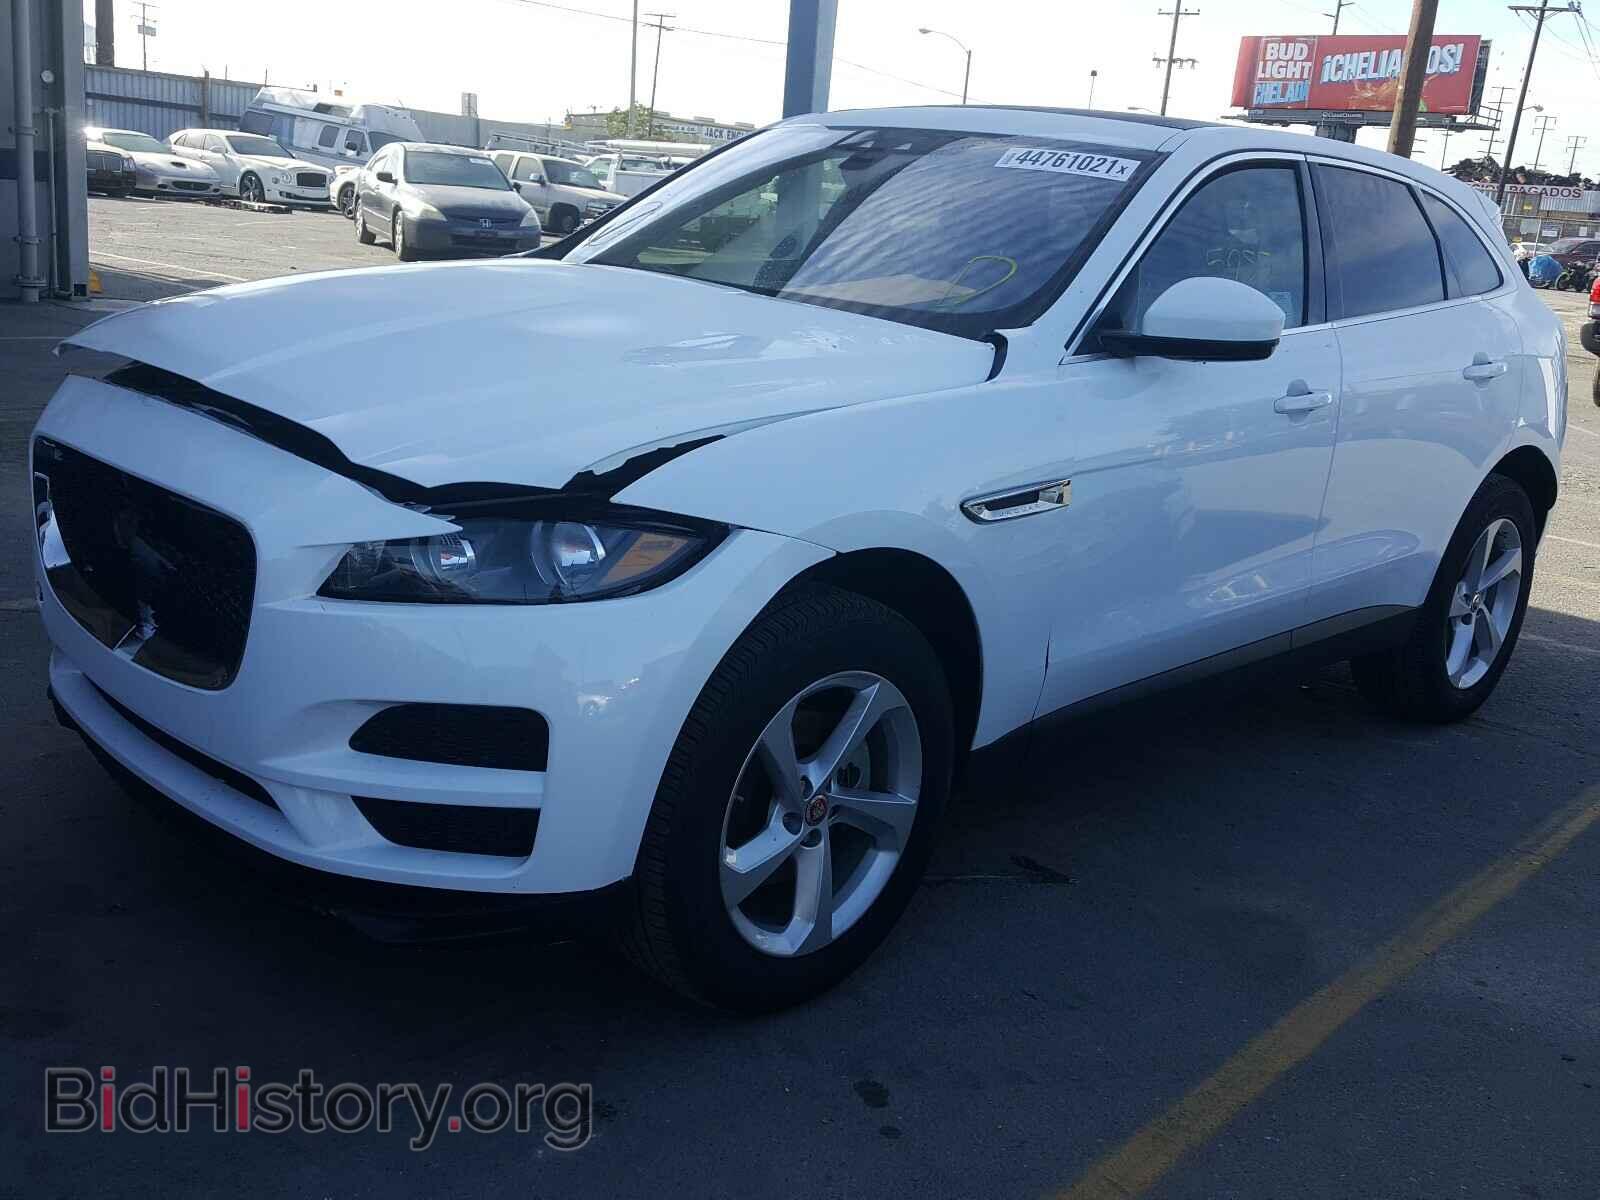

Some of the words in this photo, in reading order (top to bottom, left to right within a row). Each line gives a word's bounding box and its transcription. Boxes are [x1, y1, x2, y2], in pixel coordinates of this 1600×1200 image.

[1265, 43, 1308, 60] BUD
[1257, 61, 1312, 79] LIGHT
[704, 127, 724, 138] JACK
